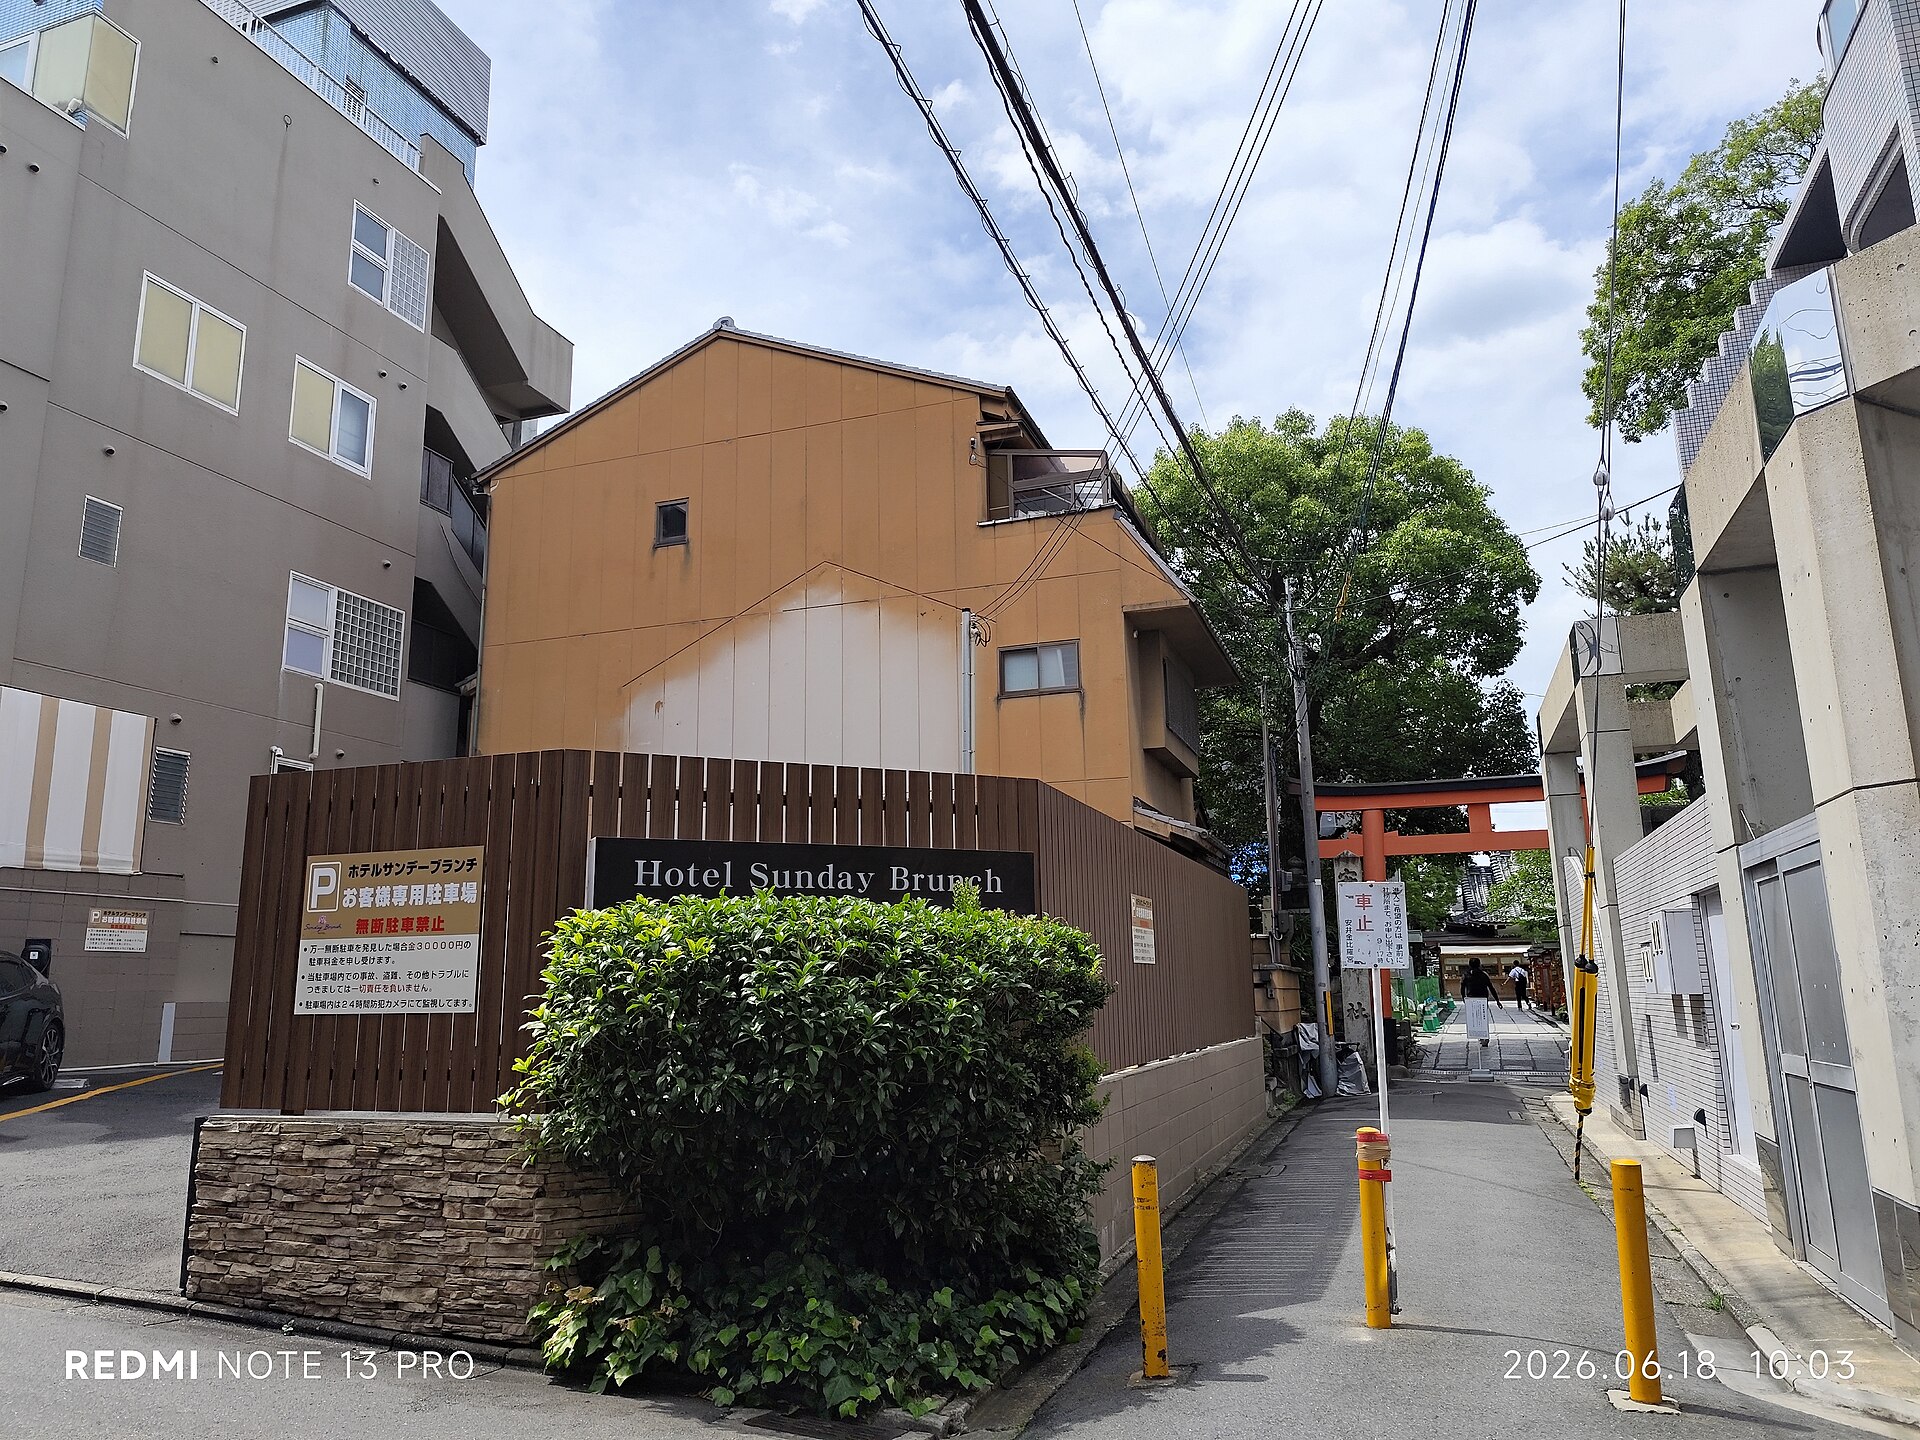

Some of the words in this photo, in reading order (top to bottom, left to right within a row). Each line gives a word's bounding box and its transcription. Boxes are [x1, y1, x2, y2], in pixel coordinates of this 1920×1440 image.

[348, 858, 478, 878] ホテルサンデーブランチ
[634, 860, 733, 889] Hotel
[750, 862, 875, 893] Sunday
[889, 866, 1004, 894] Brunch
[311, 867, 337, 909] P
[342, 882, 478, 908] お客様専用駐車場
[1355, 893, 1375, 932] 車止
[355, 916, 445, 935] 無断駐車禁止
[308, 956, 396, 966] 駐車料金を申し受けます。
[307, 970, 469, 982] 当駐車場内での事故、盗難、その他トラブルに
[307, 983, 433, 994] つきましては一切責任を負いません。
